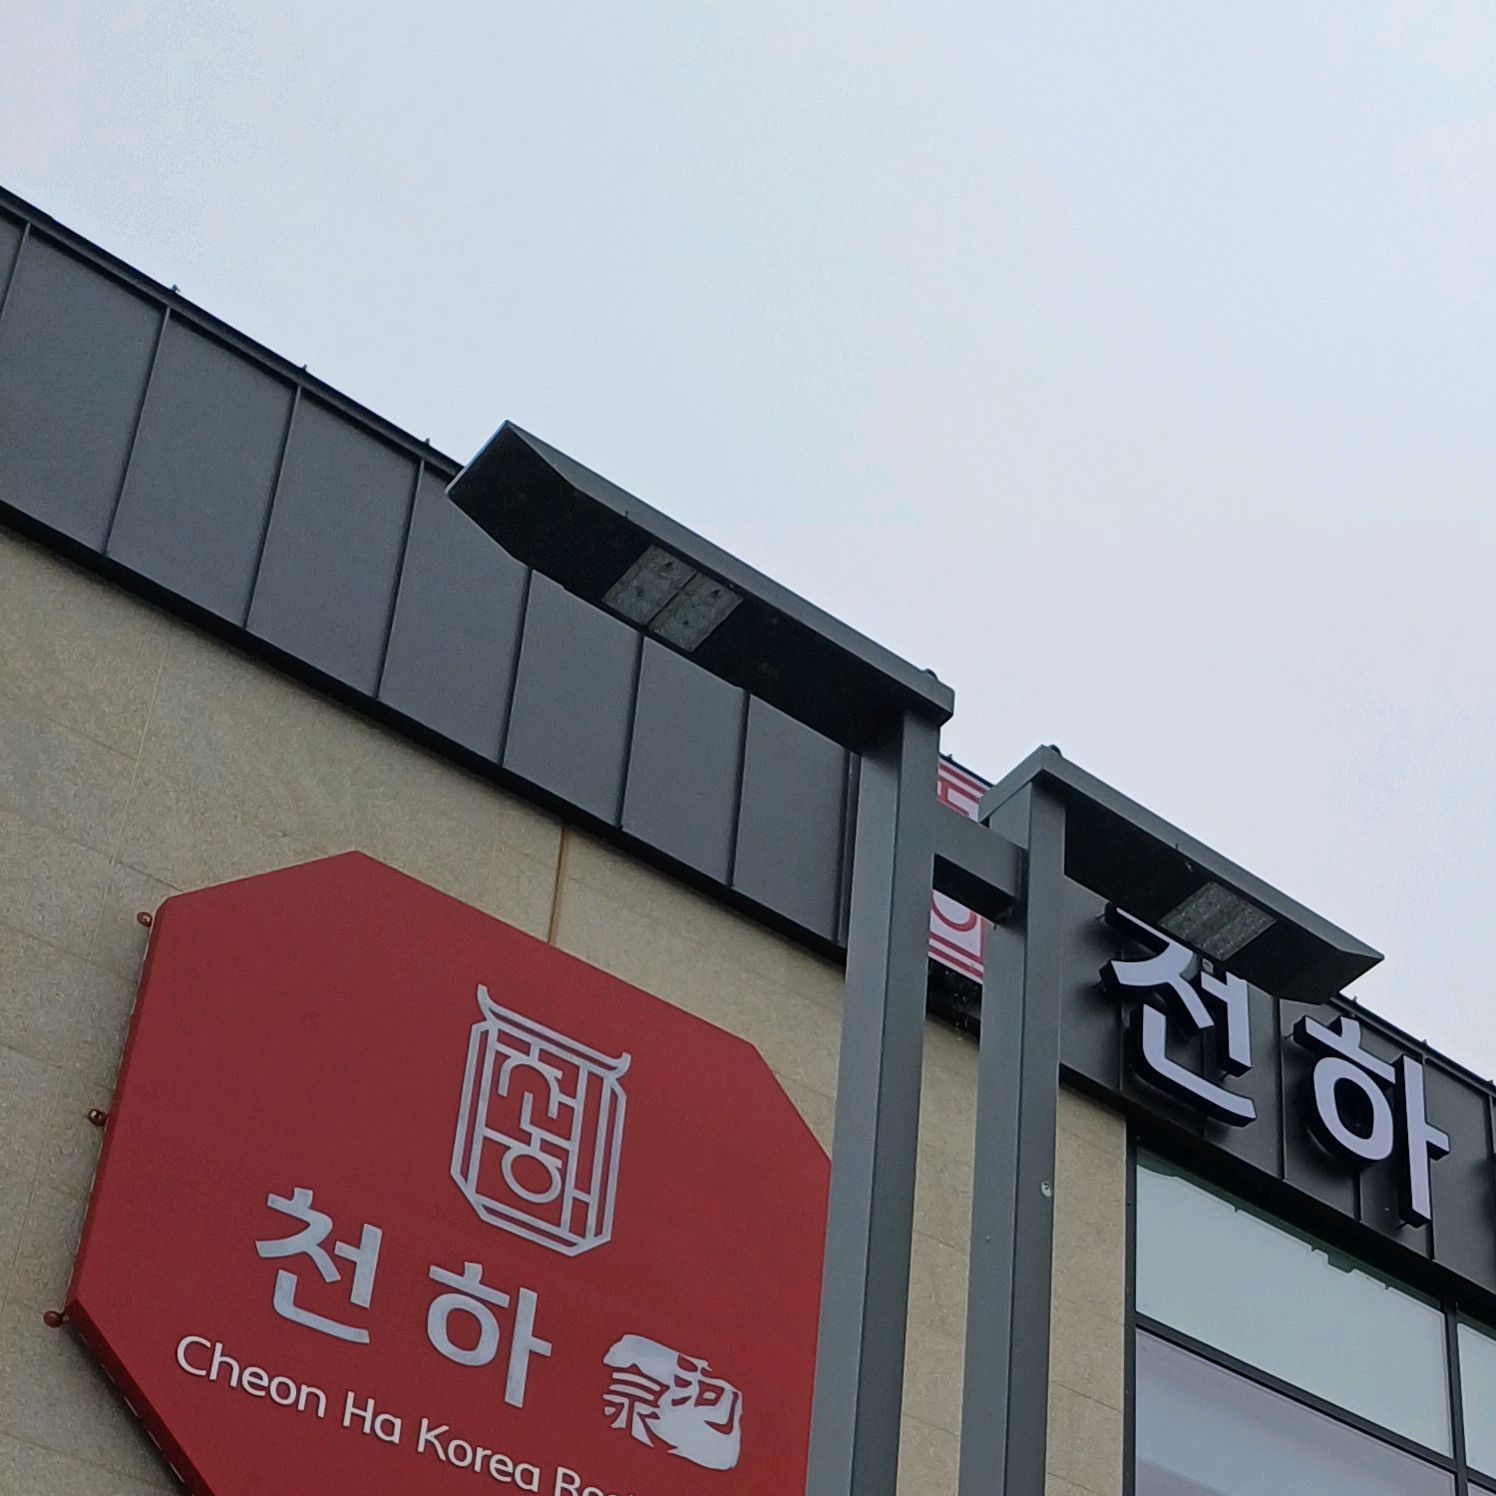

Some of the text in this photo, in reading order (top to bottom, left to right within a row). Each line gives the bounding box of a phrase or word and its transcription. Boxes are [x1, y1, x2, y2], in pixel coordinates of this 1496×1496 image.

[176, 1335, 327, 1418] Cheon
[342, 1391, 401, 1444] Ha
[417, 1417, 540, 1493] Korea
